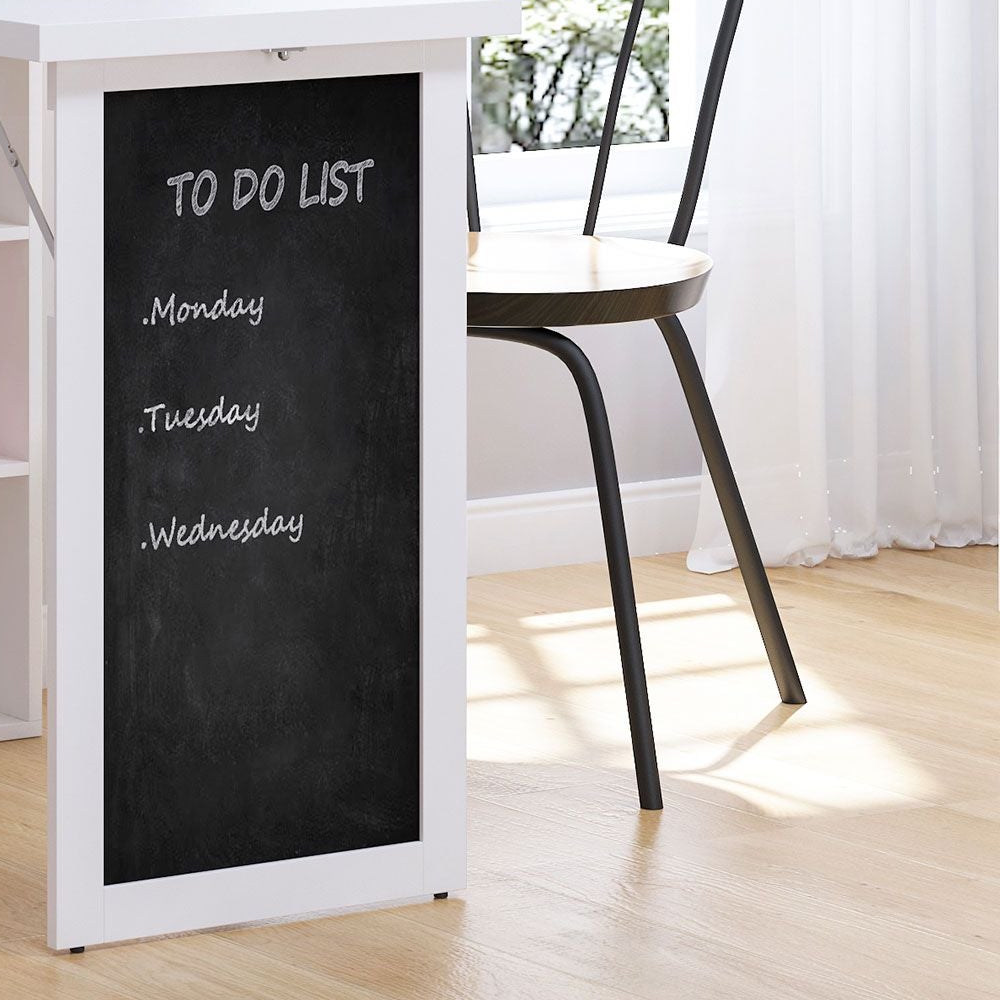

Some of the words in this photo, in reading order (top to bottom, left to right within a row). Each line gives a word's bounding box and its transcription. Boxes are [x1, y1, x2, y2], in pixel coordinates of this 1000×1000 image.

[167, 170, 218, 217] TO
[232, 164, 285, 211] DO
[299, 158, 375, 209] LIST
